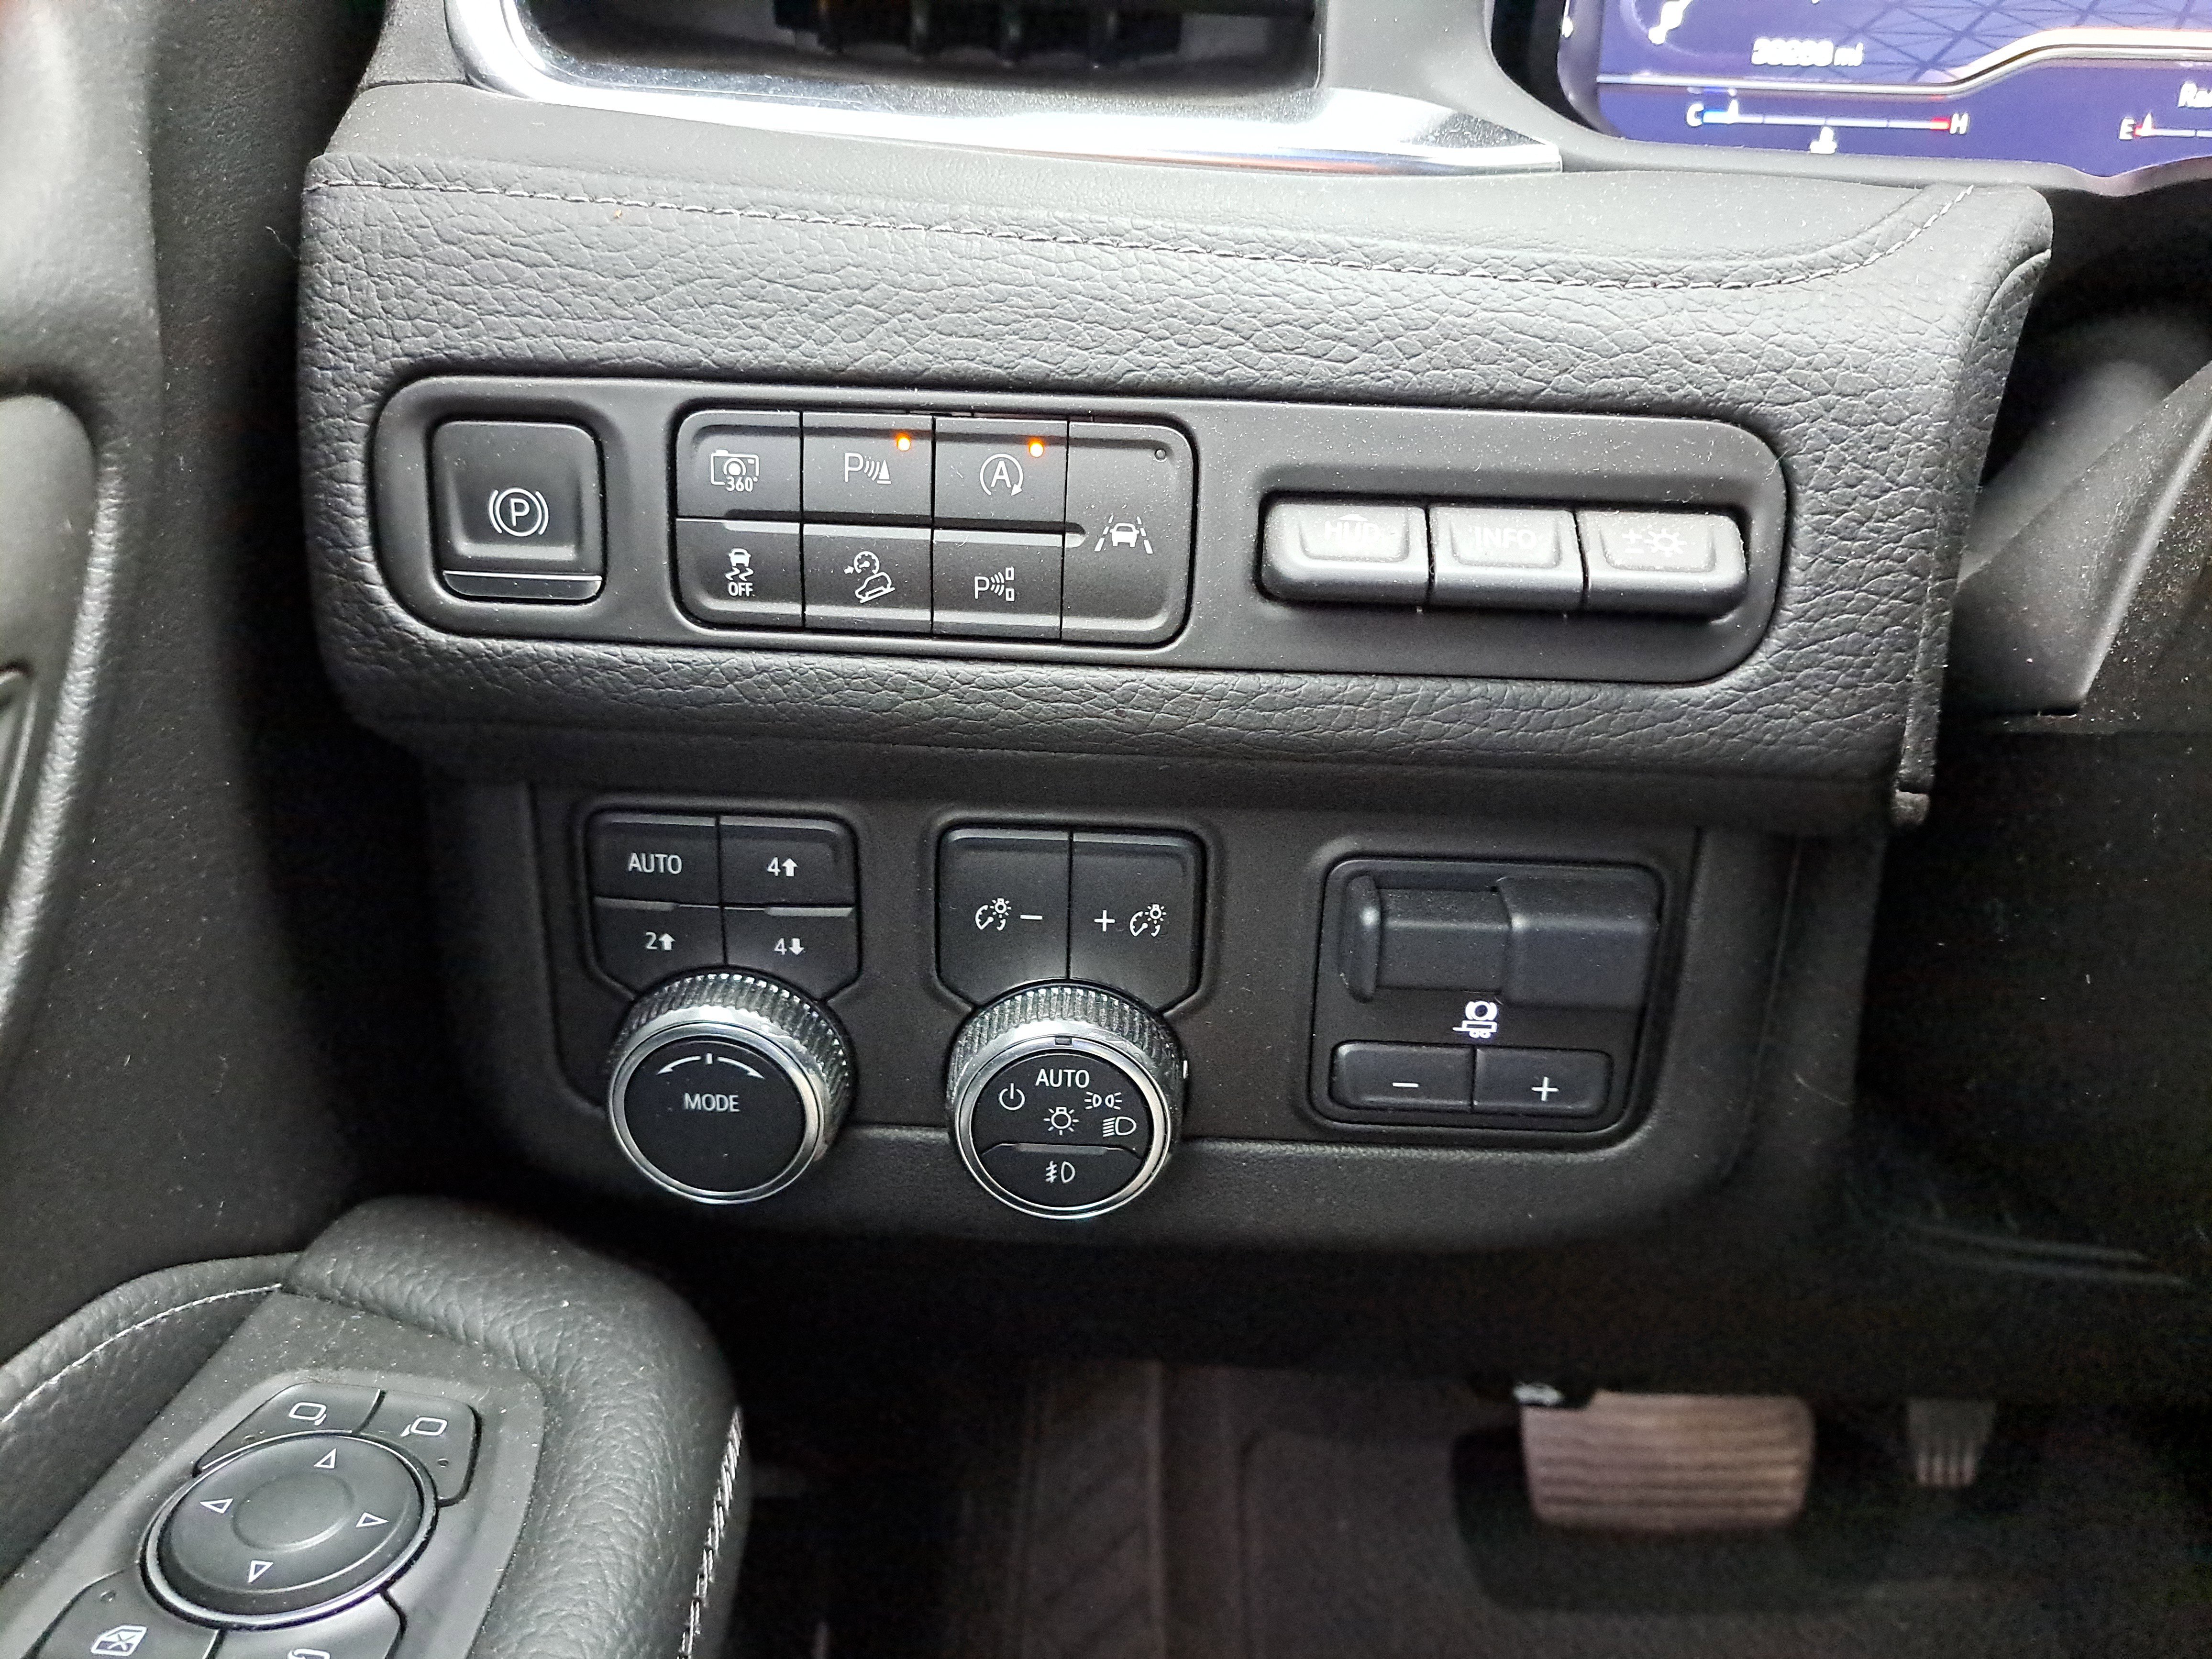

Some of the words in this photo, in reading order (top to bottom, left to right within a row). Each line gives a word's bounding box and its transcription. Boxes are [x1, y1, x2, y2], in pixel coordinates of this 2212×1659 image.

[1686, 103, 1703, 126] C
[1950, 113, 1968, 134] H
[2119, 118, 2135, 140] E
[844, 452, 863, 482] P
[990, 460, 1011, 488] A
[509, 498, 530, 526] P
[1325, 520, 1381, 543] HUD
[1475, 527, 1537, 549] INFO
[728, 582, 753, 597] OFF
[974, 576, 990, 599] P
[628, 852, 683, 874] AUTO
[766, 857, 781, 876] 4
[645, 931, 657, 950] 2
[774, 938, 787, 955] 4
[1035, 1068, 1090, 1088] AUTO
[684, 1093, 740, 1113] MODE
